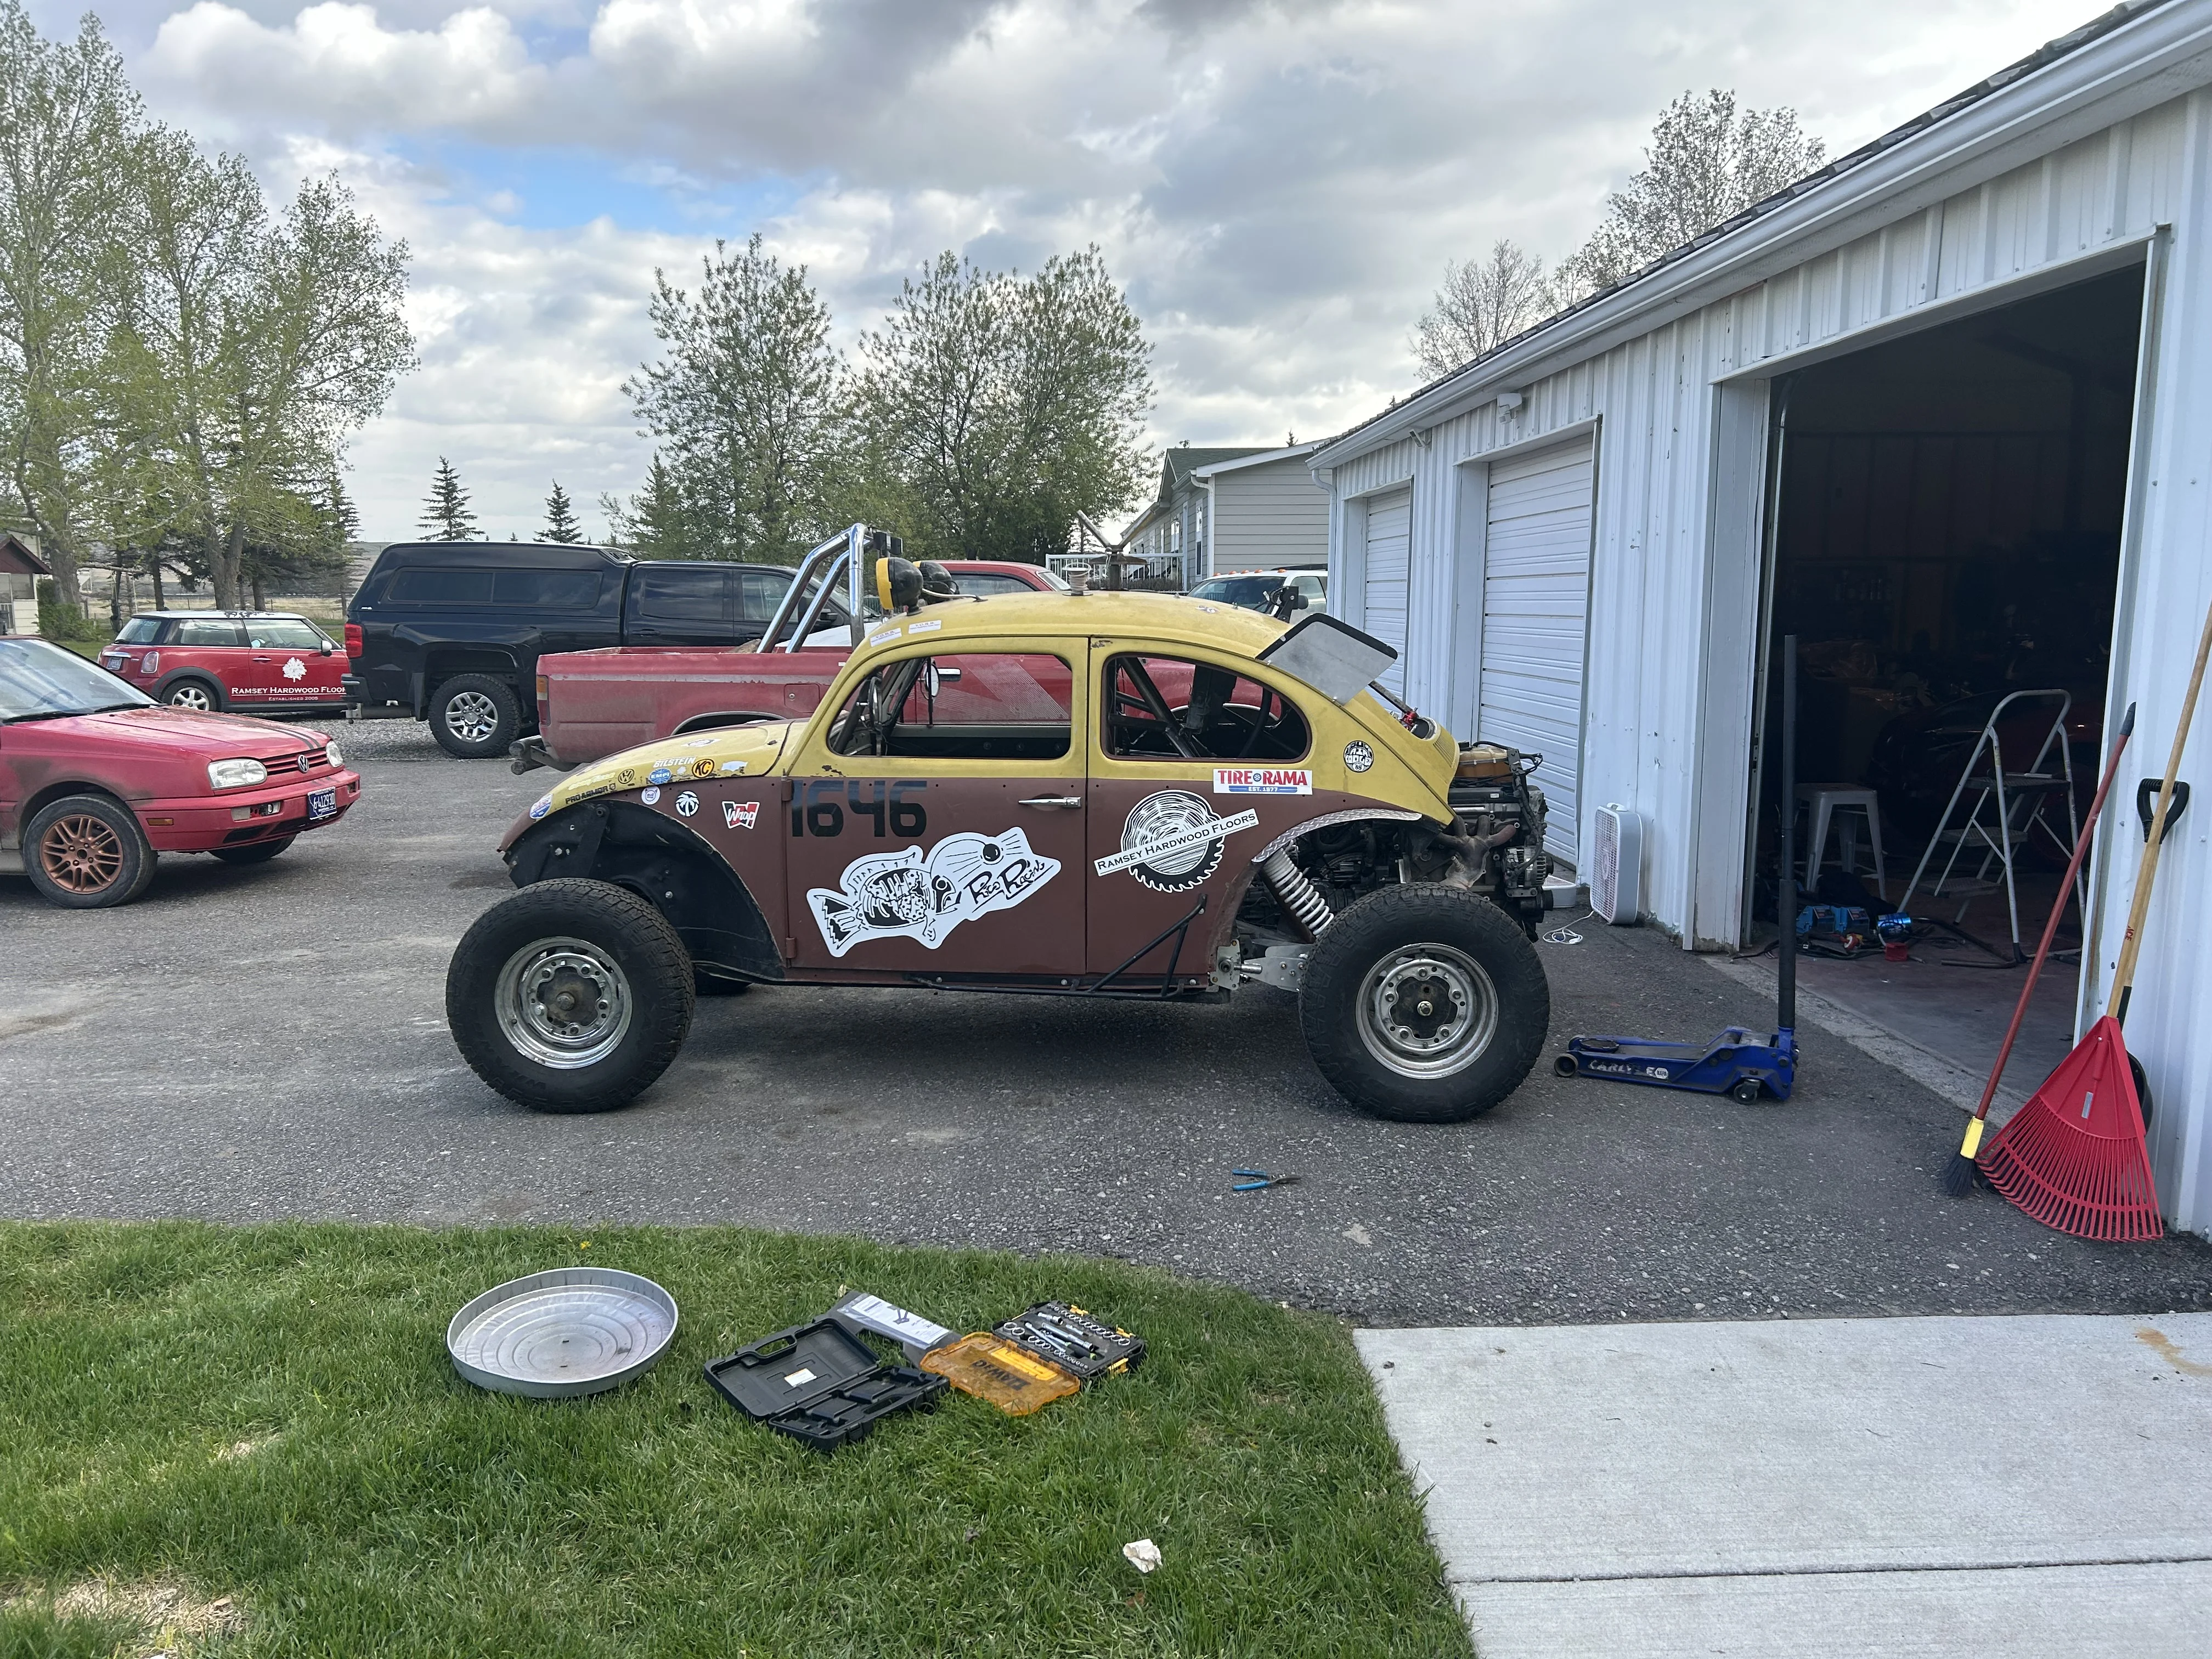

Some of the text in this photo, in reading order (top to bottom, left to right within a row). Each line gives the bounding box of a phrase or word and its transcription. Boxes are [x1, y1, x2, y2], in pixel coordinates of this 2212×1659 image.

[653, 757, 697, 768] BILSTEIN
[695, 760, 712, 776] KC
[1217, 770, 1308, 786] TIRE RAMA
[792, 780, 928, 838] 1646
[1097, 850, 1143, 870] RAMSEY
[1145, 829, 1210, 856] HARDWOOD
[1211, 813, 1256, 834] FLOORS
